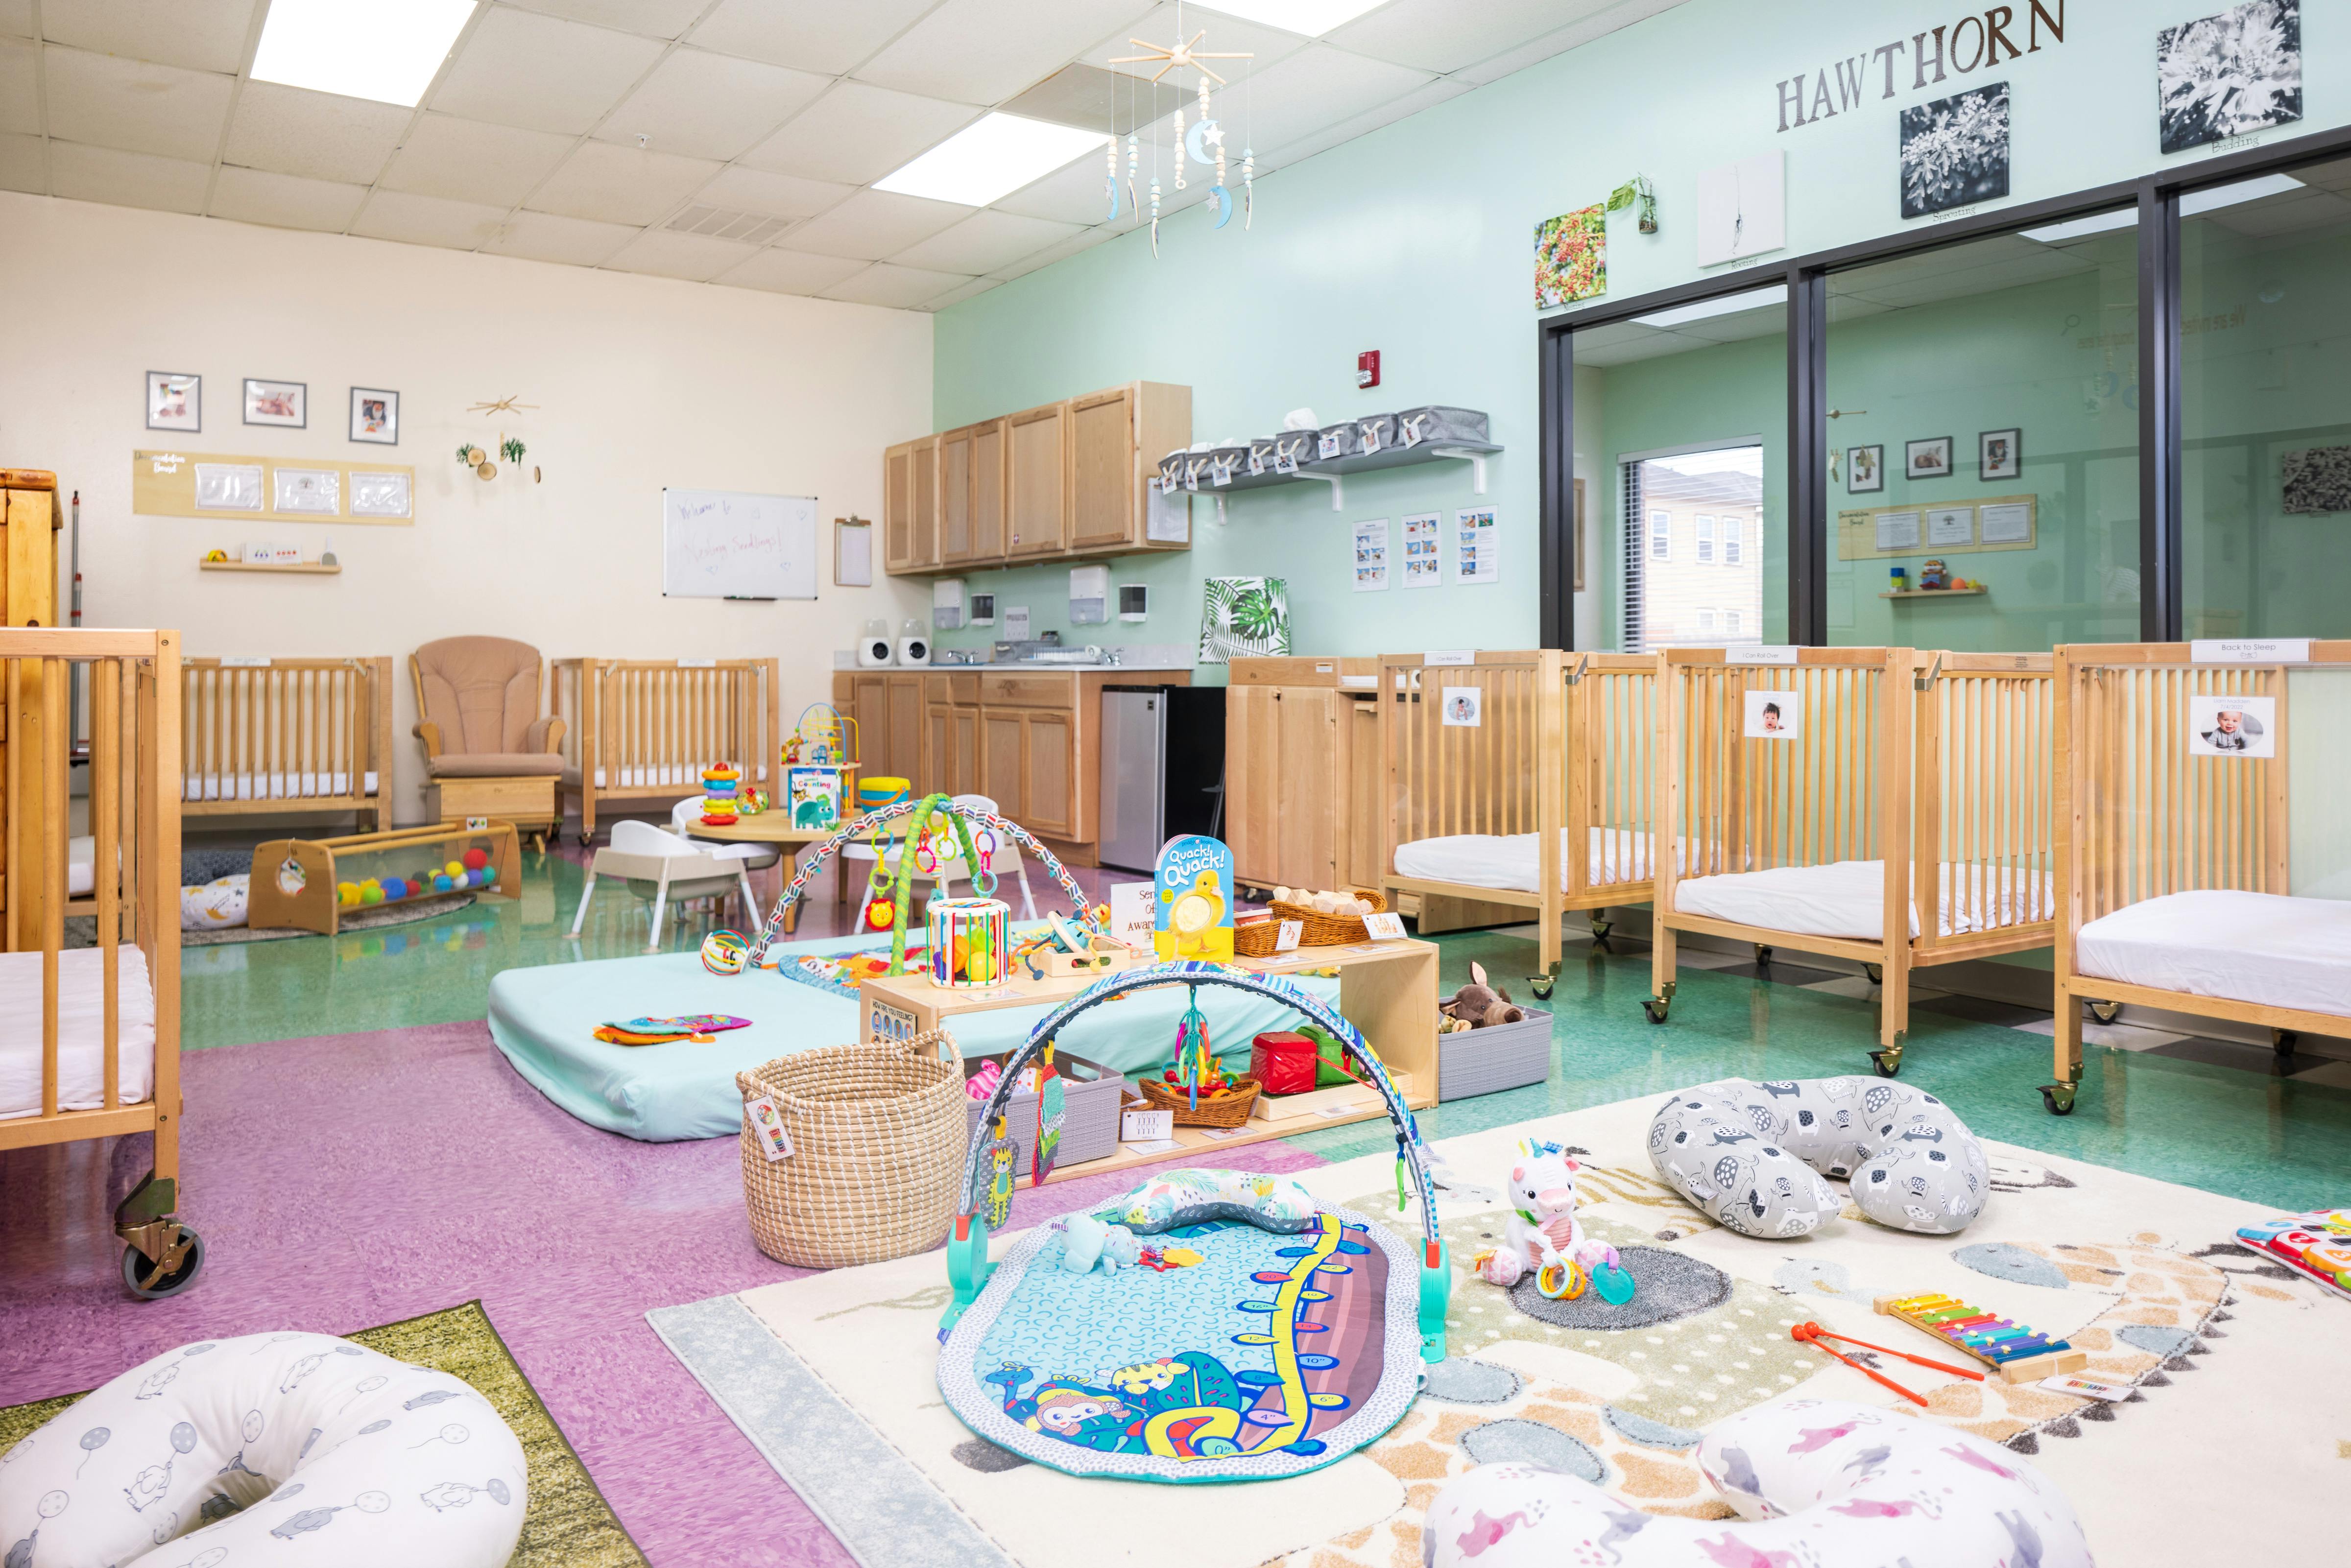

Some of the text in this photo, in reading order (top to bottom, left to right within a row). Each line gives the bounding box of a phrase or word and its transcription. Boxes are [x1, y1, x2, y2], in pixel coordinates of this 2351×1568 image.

[1775, 0, 2063, 133] HAWTHORN
[2211, 136, 2260, 153] Budding
[1932, 206, 1977, 222] Sprouting
[1731, 258, 1758, 270] Rooting
[798, 780, 831, 790] Counting
[1181, 839, 1194, 847] priddy
[1169, 844, 1211, 865] Quack!
[1164, 850, 1225, 887] Quack!
[1139, 890, 1155, 900] Sen
[1127, 920, 1155, 931] Aware
[872, 1000, 881, 1009] HOW
[896, 1010, 913, 1022] FEELING?
[2332, 1250, 2349, 1259] 3
